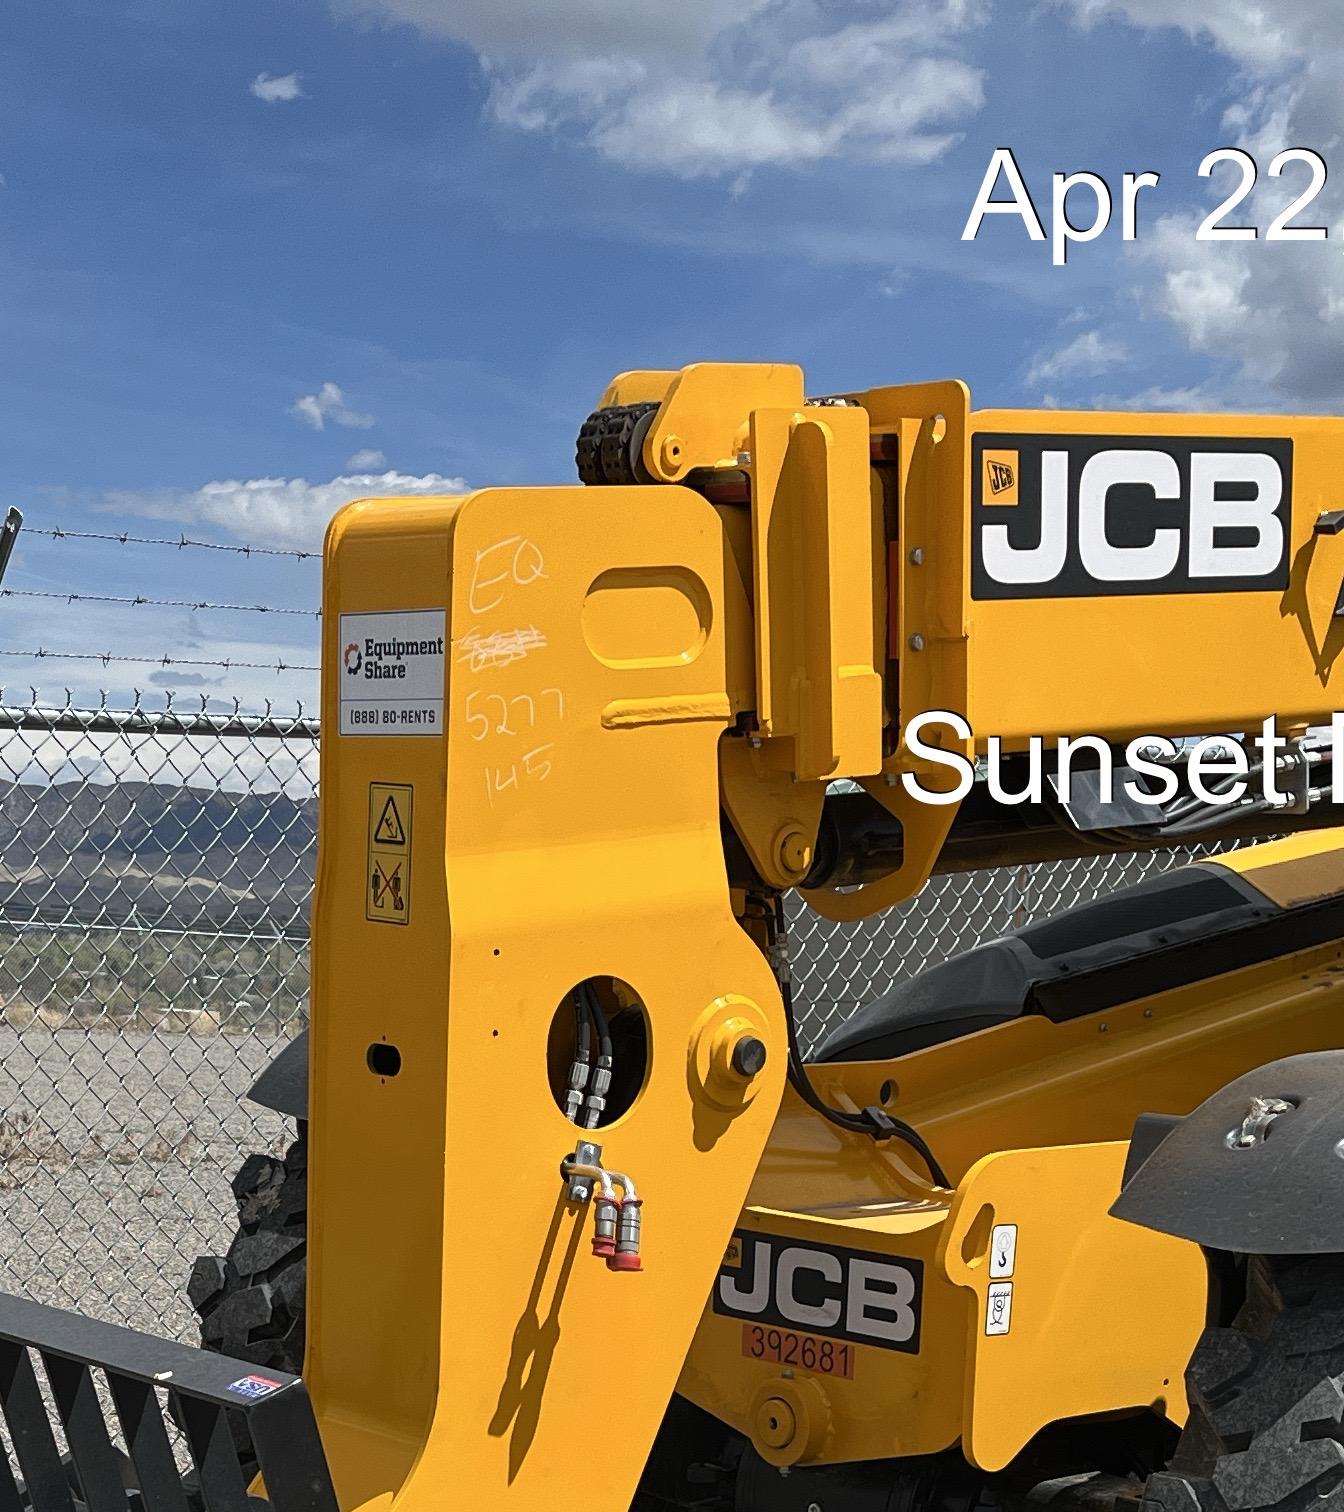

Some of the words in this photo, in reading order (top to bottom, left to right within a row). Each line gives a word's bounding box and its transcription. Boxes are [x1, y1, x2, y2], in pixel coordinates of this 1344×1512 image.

[981, 450, 1283, 584] JCB
[365, 637, 444, 660] Equipment
[365, 661, 406, 679] Share
[382, 709, 436, 724] 80-RENTS
[720, 1241, 915, 1342] JCB
[751, 1325, 849, 1377] 392681
